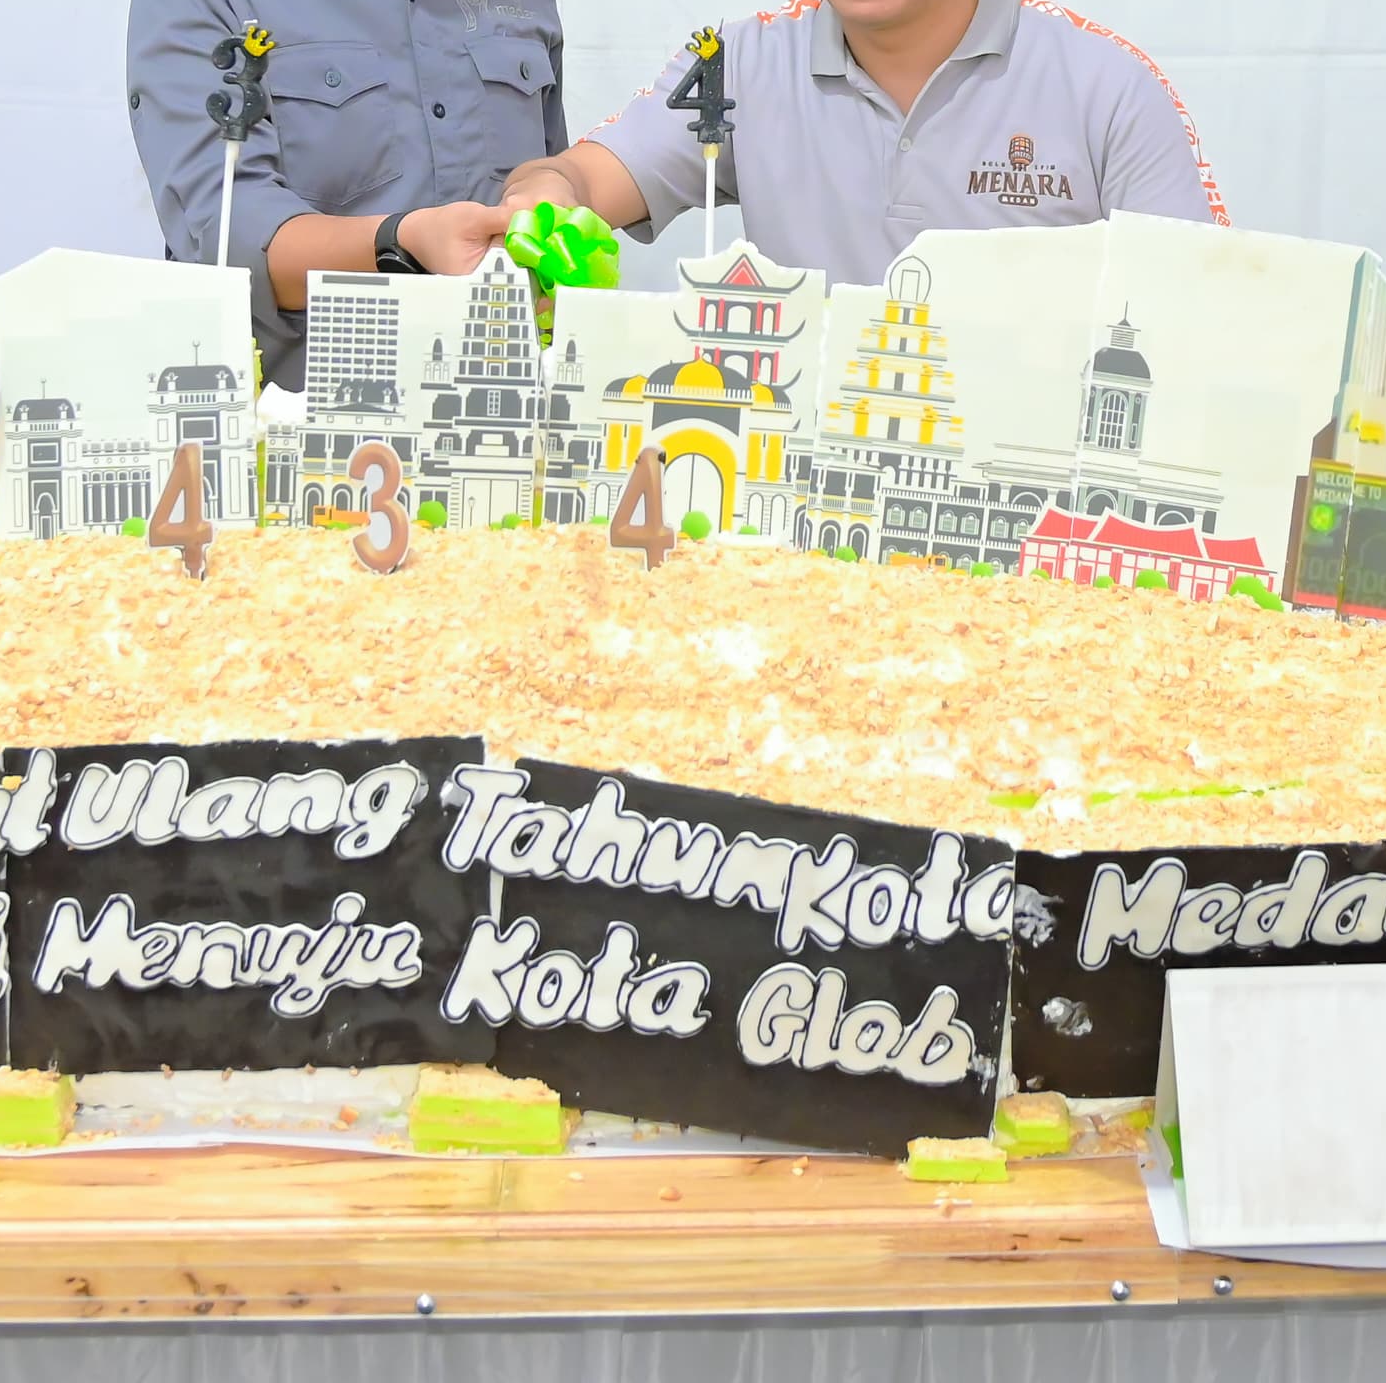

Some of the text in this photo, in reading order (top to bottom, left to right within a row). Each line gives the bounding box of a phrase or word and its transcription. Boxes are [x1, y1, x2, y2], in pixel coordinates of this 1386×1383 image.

[206, 37, 269, 141] 3
[666, 35, 736, 143] 4
[966, 170, 1073, 200] MENARA
[149, 441, 675, 579] 4 3 4
[62, 756, 426, 863] Ulang
[443, 762, 795, 912] Tahun
[34, 893, 424, 1019] Menuju
[439, 915, 712, 1038] Kota
[735, 962, 977, 1086] Glob
